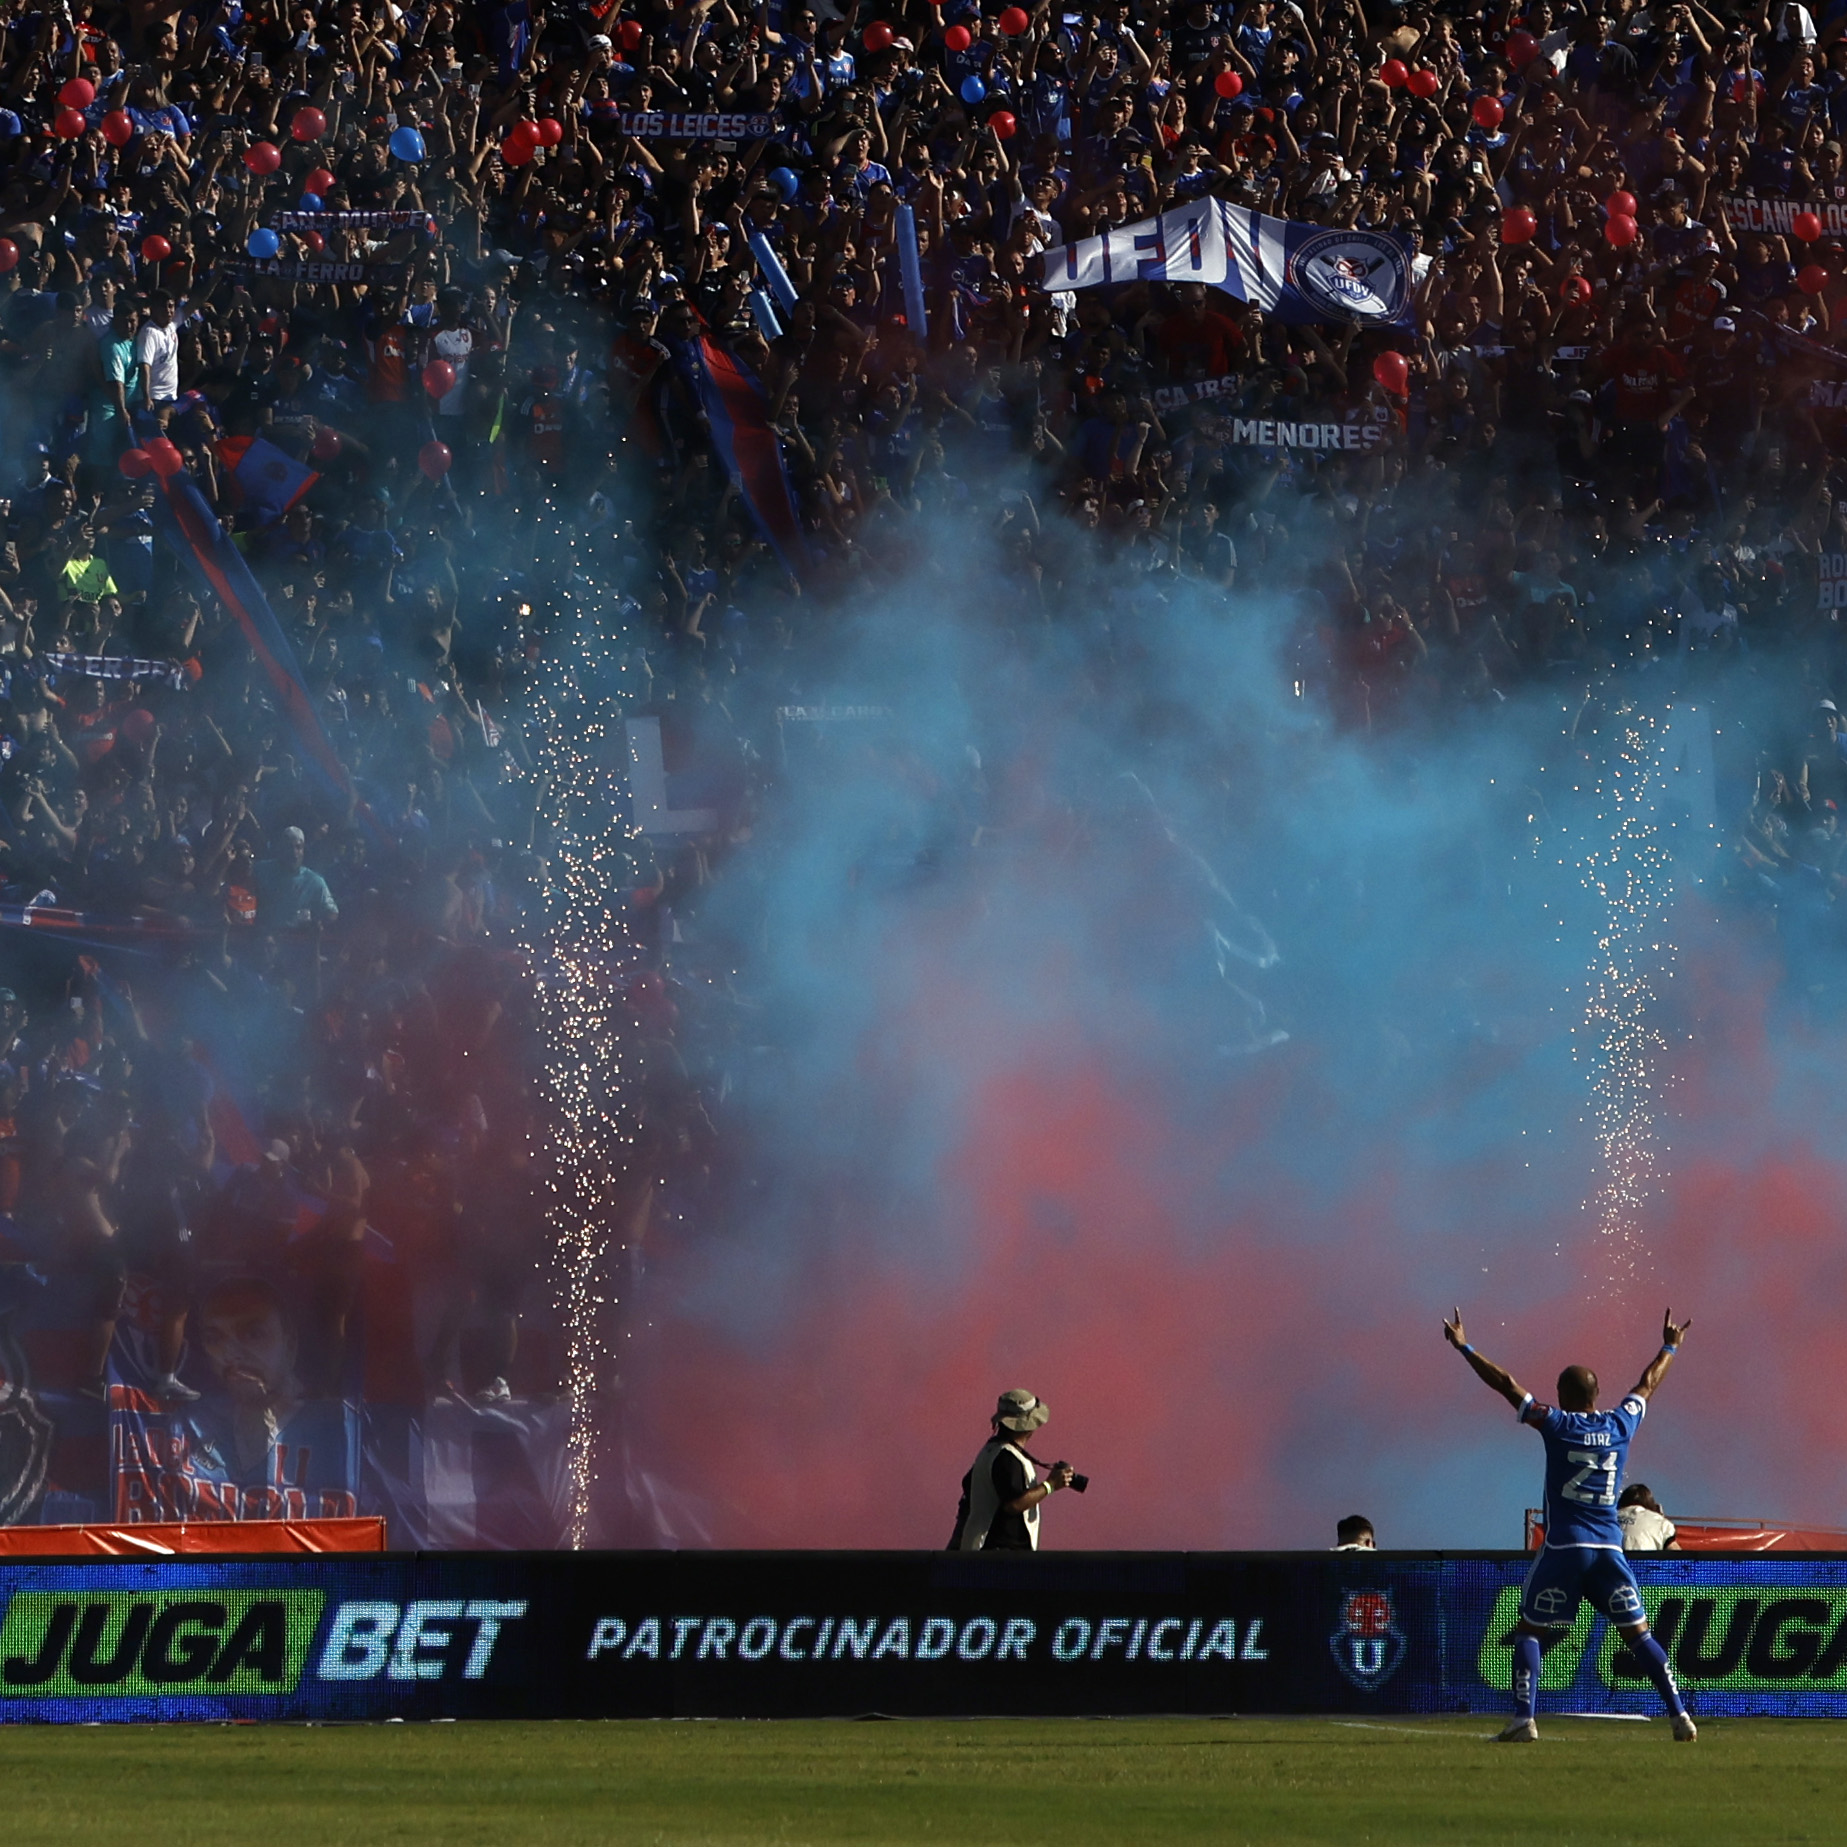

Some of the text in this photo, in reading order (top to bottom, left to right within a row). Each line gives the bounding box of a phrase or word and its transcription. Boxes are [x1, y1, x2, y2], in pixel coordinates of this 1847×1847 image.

[621, 113, 747, 137] LOS LEICES
[296, 261, 363, 281] FERRO
[1232, 419, 1379, 449] MENORES
[1562, 1448, 1621, 1505] 21
[5, 1599, 529, 1685] JUGA BET
[588, 1616, 1269, 1660] PATROCINADOR OFICIAL
